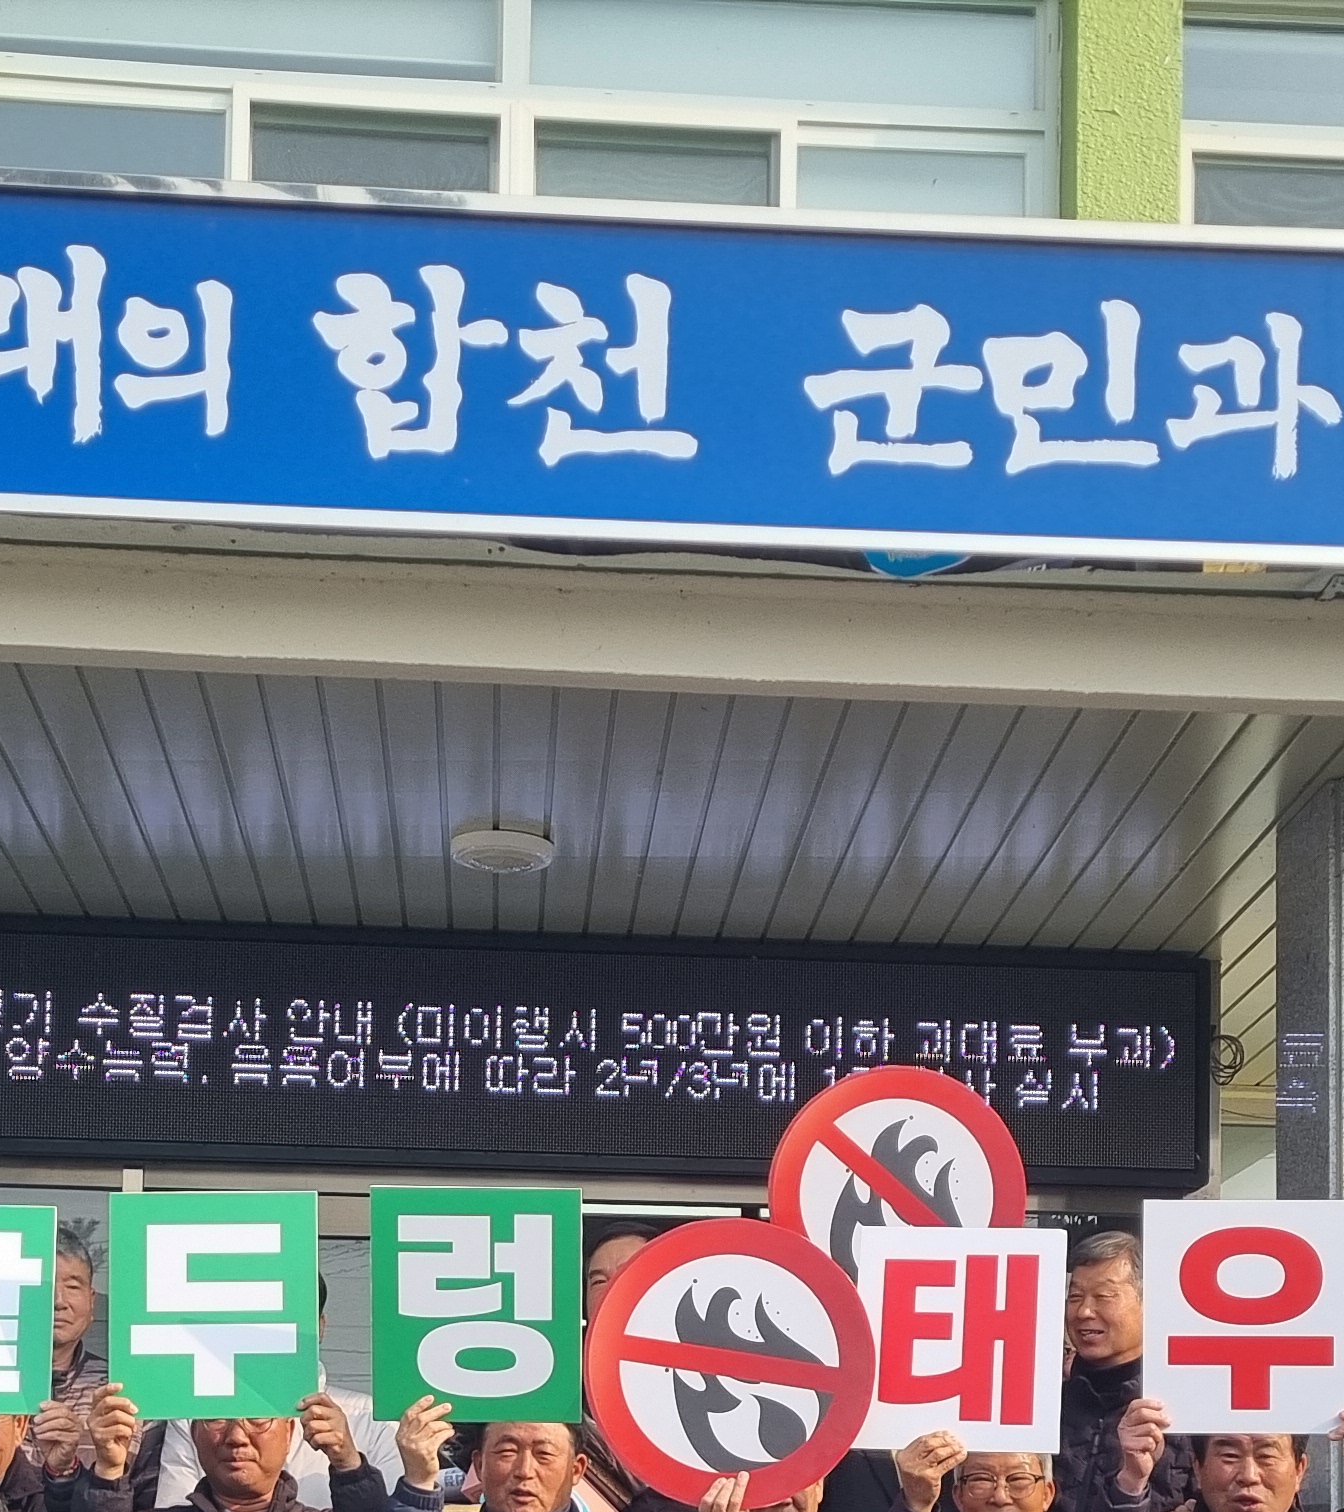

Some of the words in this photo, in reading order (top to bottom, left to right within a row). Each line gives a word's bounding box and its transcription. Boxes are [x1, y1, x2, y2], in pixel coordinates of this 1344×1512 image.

[313, 265, 697, 466] 합천
[804, 300, 1342, 478] 군민과
[287, 999, 372, 1044] 안내
[805, 1016, 895, 1061] 이하
[485, 1053, 576, 1096] 따라
[131, 1224, 296, 1396] 두
[398, 1215, 553, 1397] 렁
[878, 1255, 1038, 1425] 태
[1169, 1227, 1334, 1409] 우
